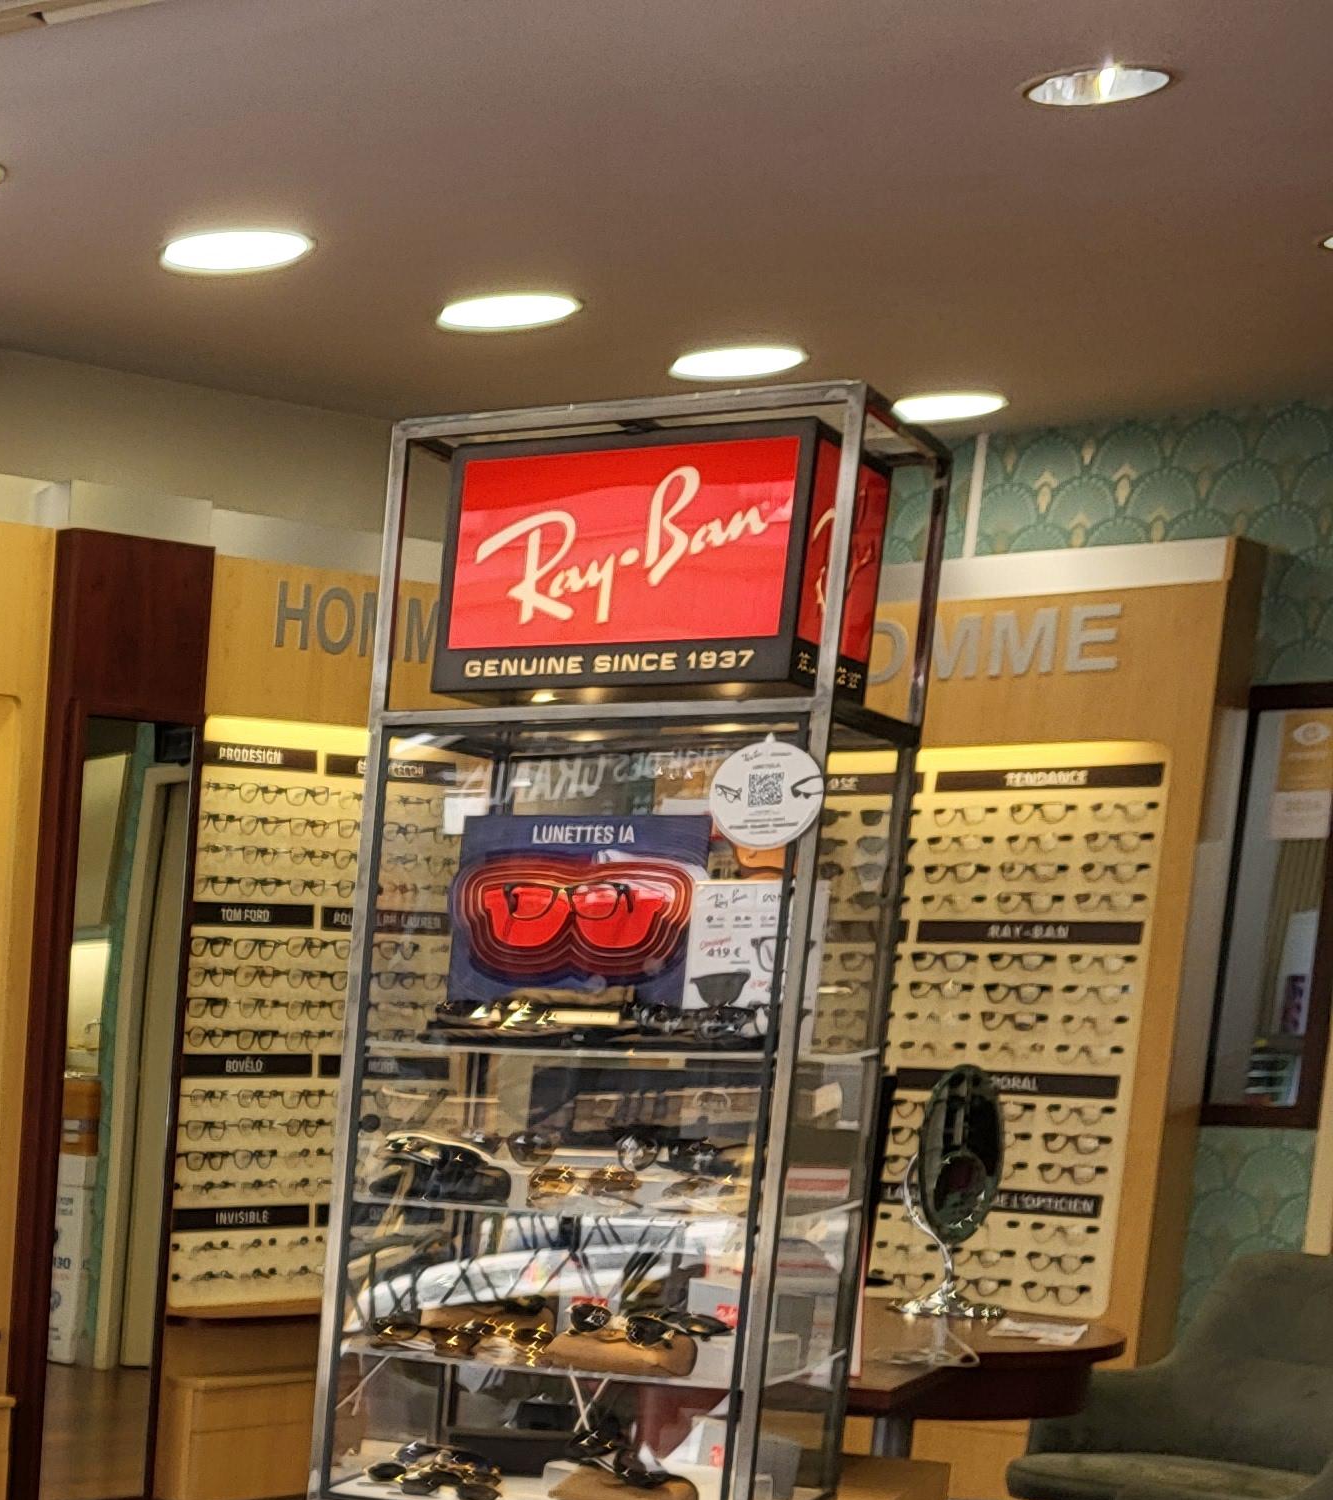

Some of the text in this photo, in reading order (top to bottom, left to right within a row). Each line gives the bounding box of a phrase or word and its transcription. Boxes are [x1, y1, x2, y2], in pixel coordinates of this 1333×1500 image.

[864, 602, 1124, 687] OMME
[463, 649, 756, 679] GENUINE SINCE 1937
[218, 745, 283, 765] PRODESIGN
[532, 823, 636, 845] LUNETTES IA
[220, 907, 270, 922] TOM FORD
[988, 924, 1070, 939] RAY-BAN
[215, 1210, 270, 1225] INVISIBLE
